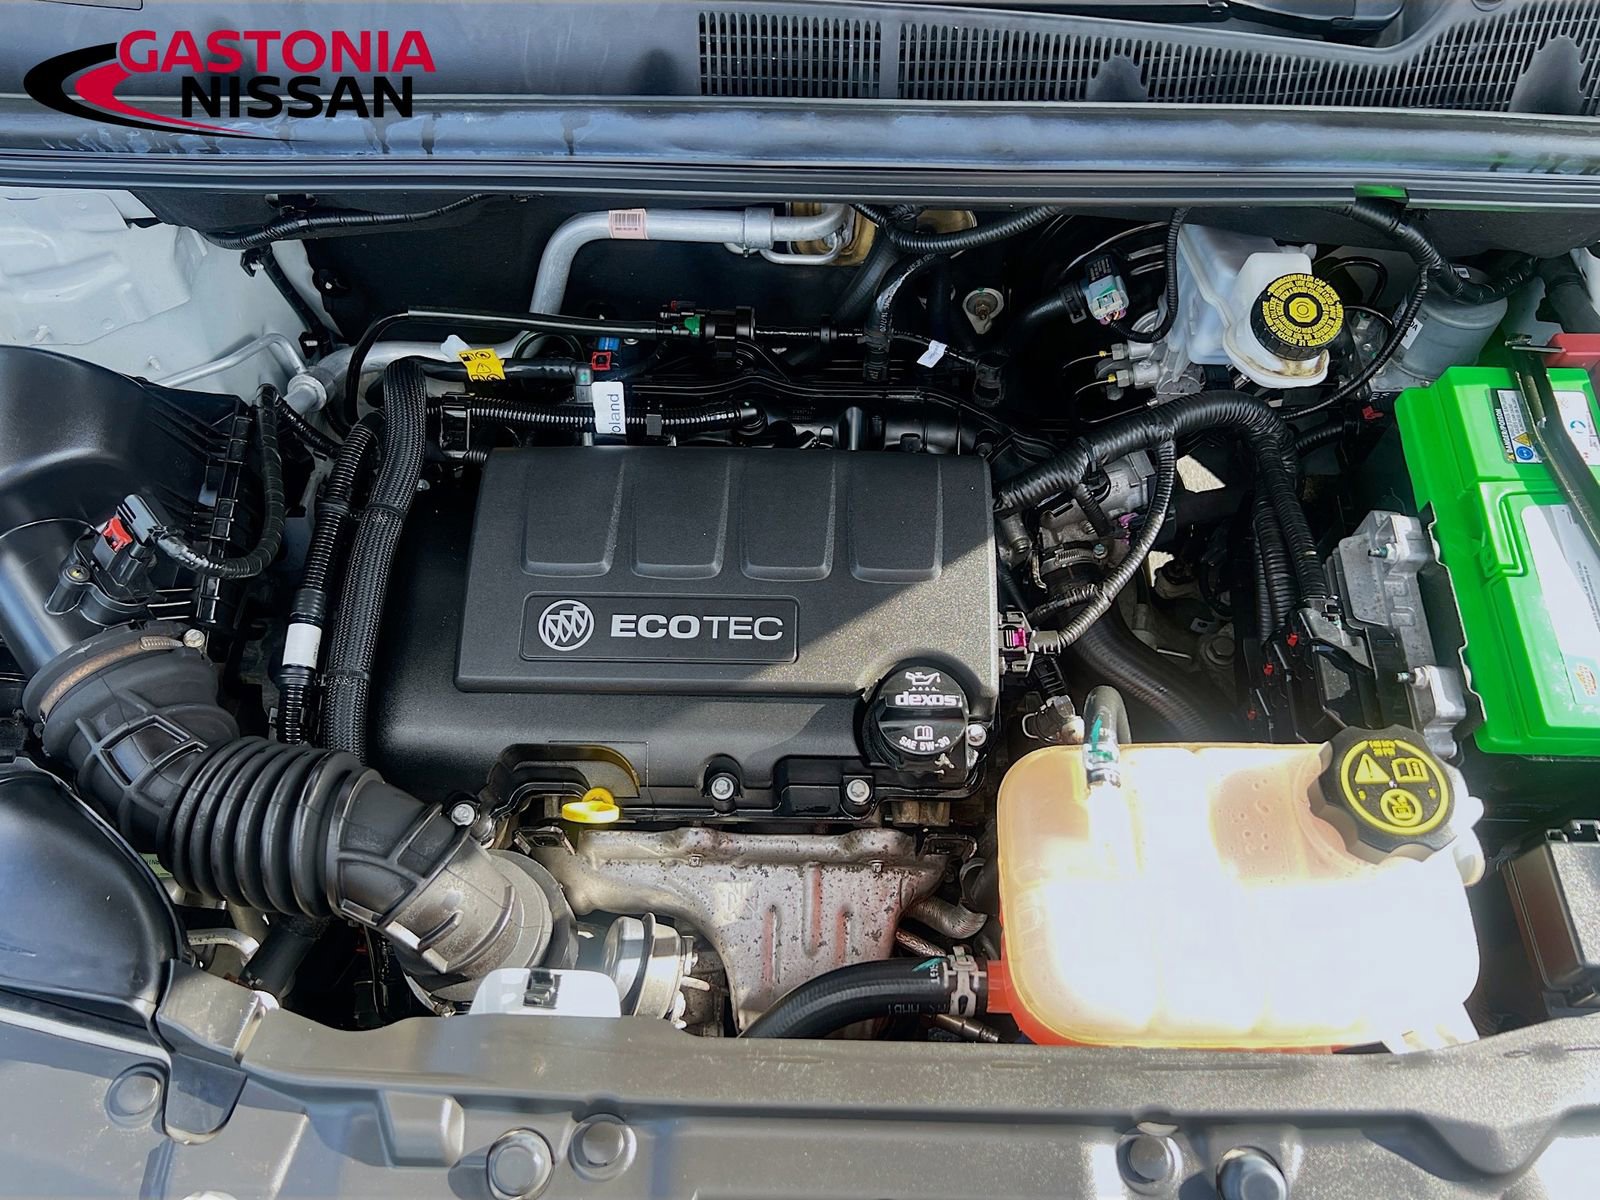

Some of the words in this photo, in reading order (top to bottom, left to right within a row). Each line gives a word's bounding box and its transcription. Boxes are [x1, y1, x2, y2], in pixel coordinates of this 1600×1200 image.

[610, 614, 784, 641] ECOTEC
[895, 691, 957, 706] dexos
[899, 736, 918, 750] SAE
[920, 736, 951, 751] 5W-30
